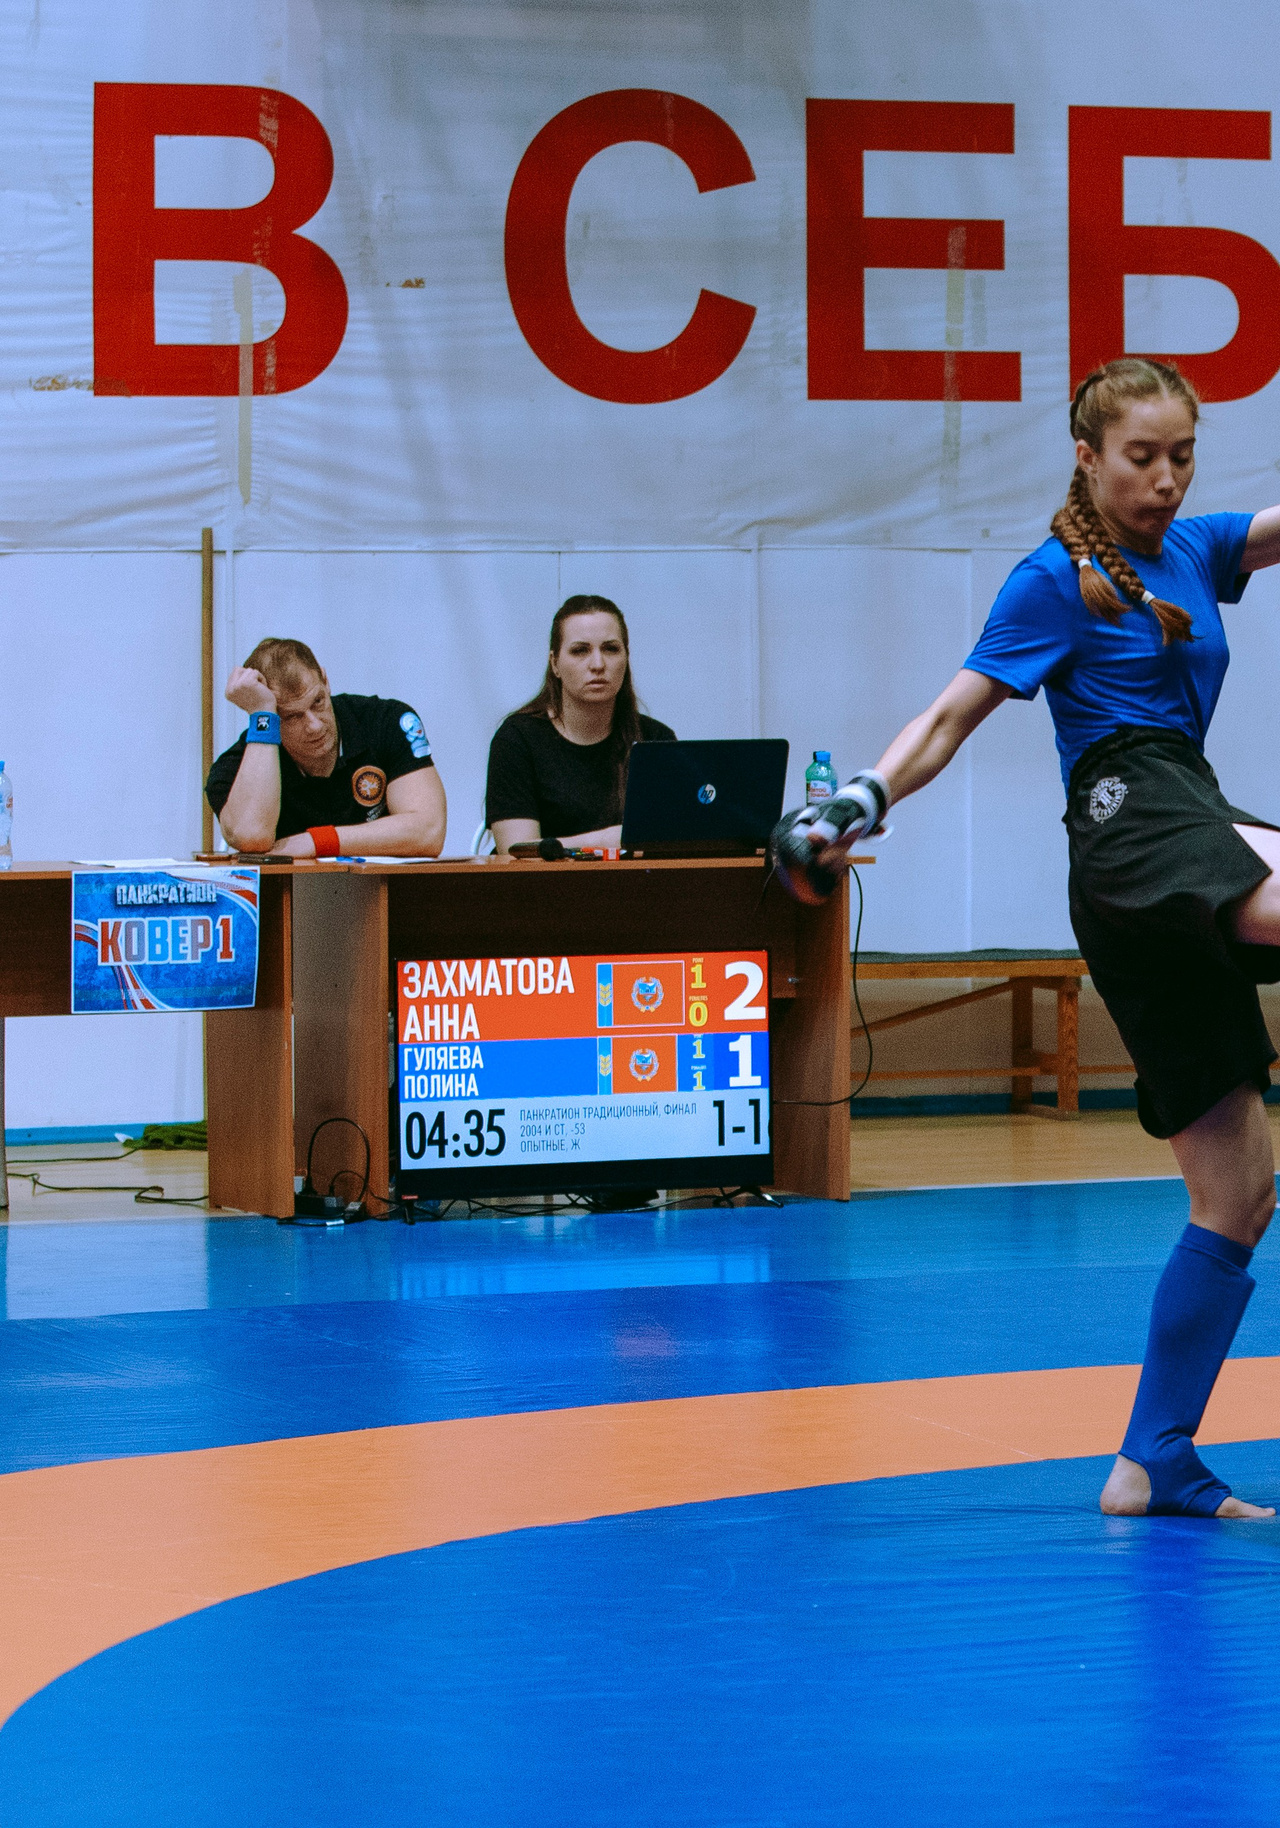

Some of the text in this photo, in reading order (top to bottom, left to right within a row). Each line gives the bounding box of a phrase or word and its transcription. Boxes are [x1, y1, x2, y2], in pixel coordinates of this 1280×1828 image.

[93, 81, 349, 397] В
[116, 883, 217, 905] ПАНКРАТИОН
[98, 915, 235, 966] КОВЕР 1
[403, 957, 575, 999] ЗАХМАТОВА
[690, 964, 707, 989] 1
[724, 961, 766, 1021] 2
[403, 1003, 481, 1042] АННА
[688, 1001, 708, 1027] 0
[404, 1045, 484, 1071] ГУЛЯЕВА
[692, 1039, 706, 1059] 1
[728, 1034, 762, 1087] 1
[404, 1073, 479, 1099] ПОЛИНА
[692, 1071, 706, 1091] 1
[520, 1101, 697, 1121] ПАНКРАТИОН ТРАДИЦИОННЫЙ, ФИНАЛ
[713, 1098, 770, 1146] 1-1
[405, 1108, 506, 1160] 04:35
[520, 1124, 542, 1137] 2004
[545, 1124, 551, 1135] И
[571, 1122, 586, 1135] -53
[520, 1138, 581, 1152] ОПЫТНЫЕ, Ж
